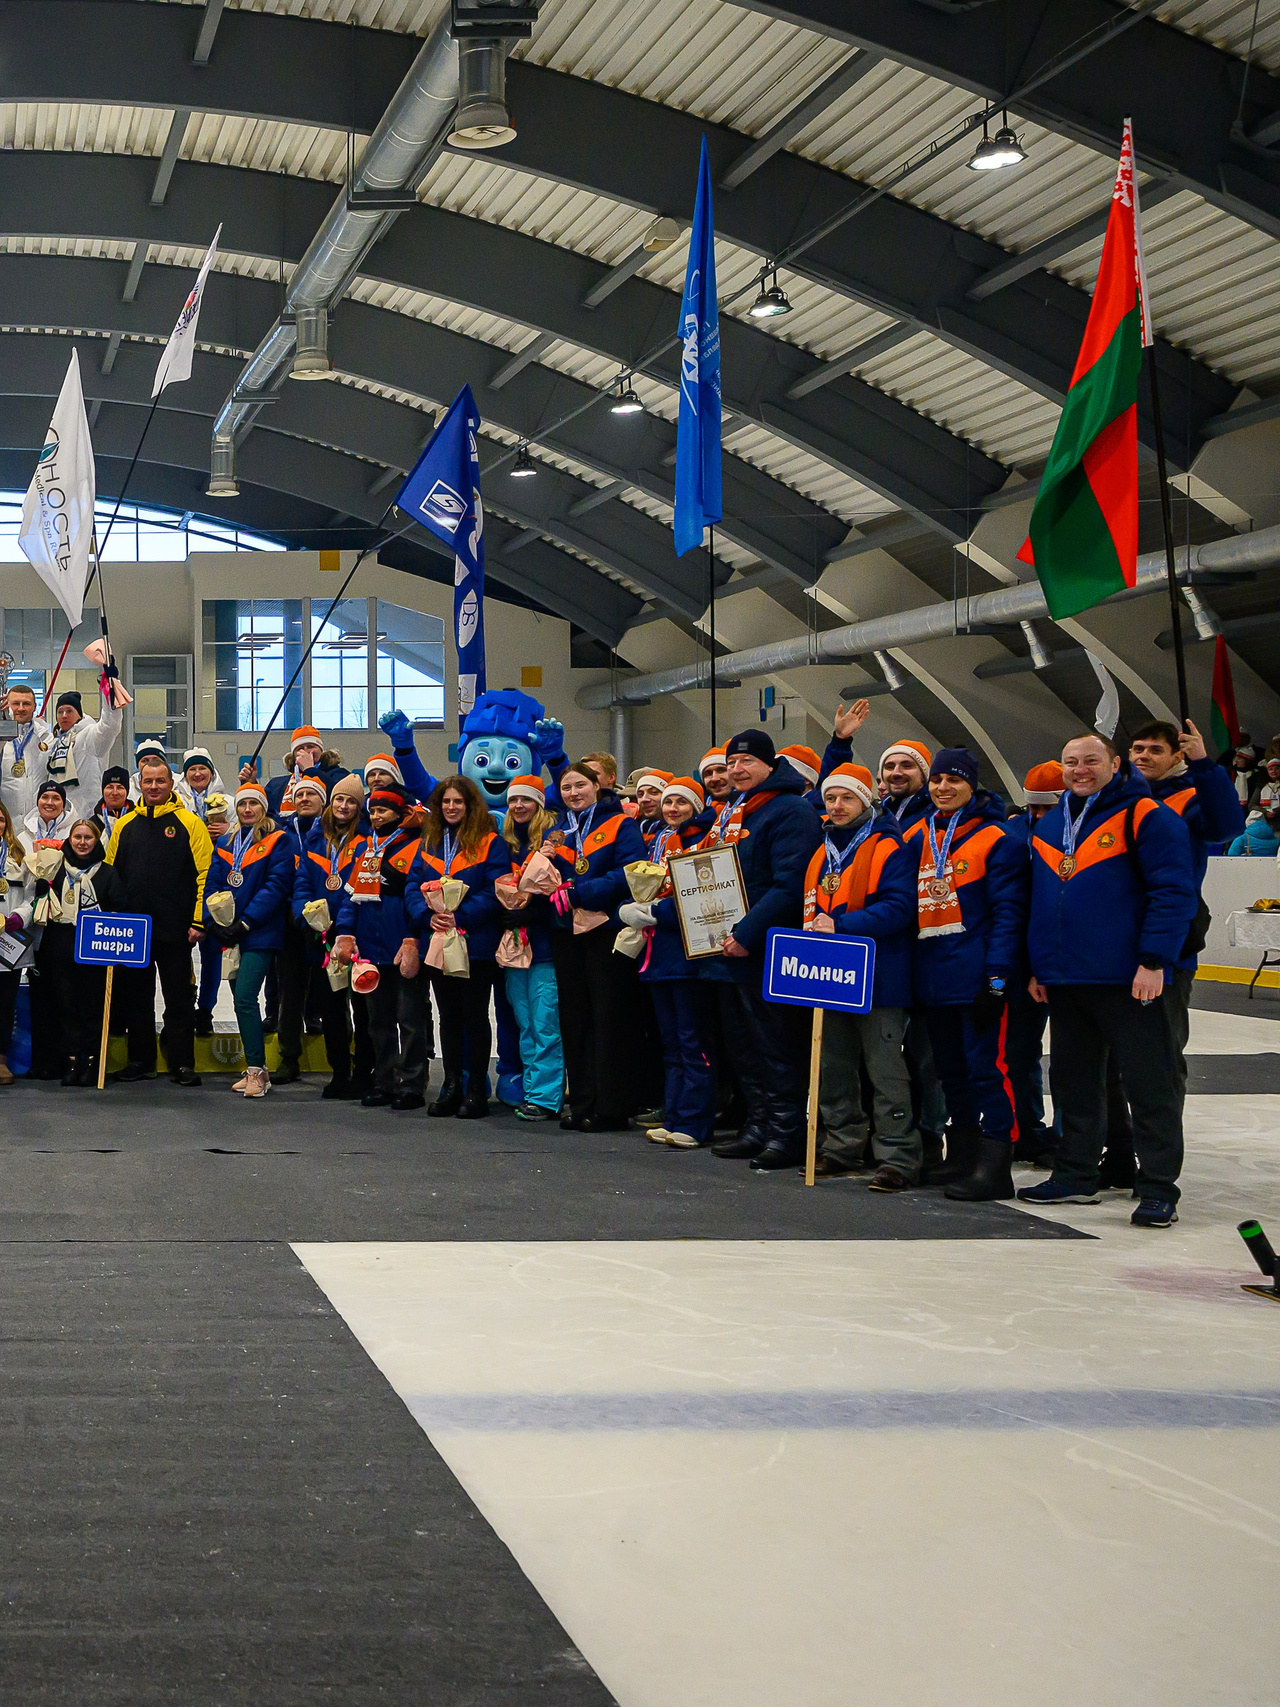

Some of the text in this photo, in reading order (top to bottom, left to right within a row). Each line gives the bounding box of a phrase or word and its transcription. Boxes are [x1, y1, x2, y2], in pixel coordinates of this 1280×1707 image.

[680, 879, 736, 897] СЕРТИФИКАТ
[94, 922, 134, 938] Белые
[91, 940, 135, 955] тигры
[780, 956, 856, 986] Молния
